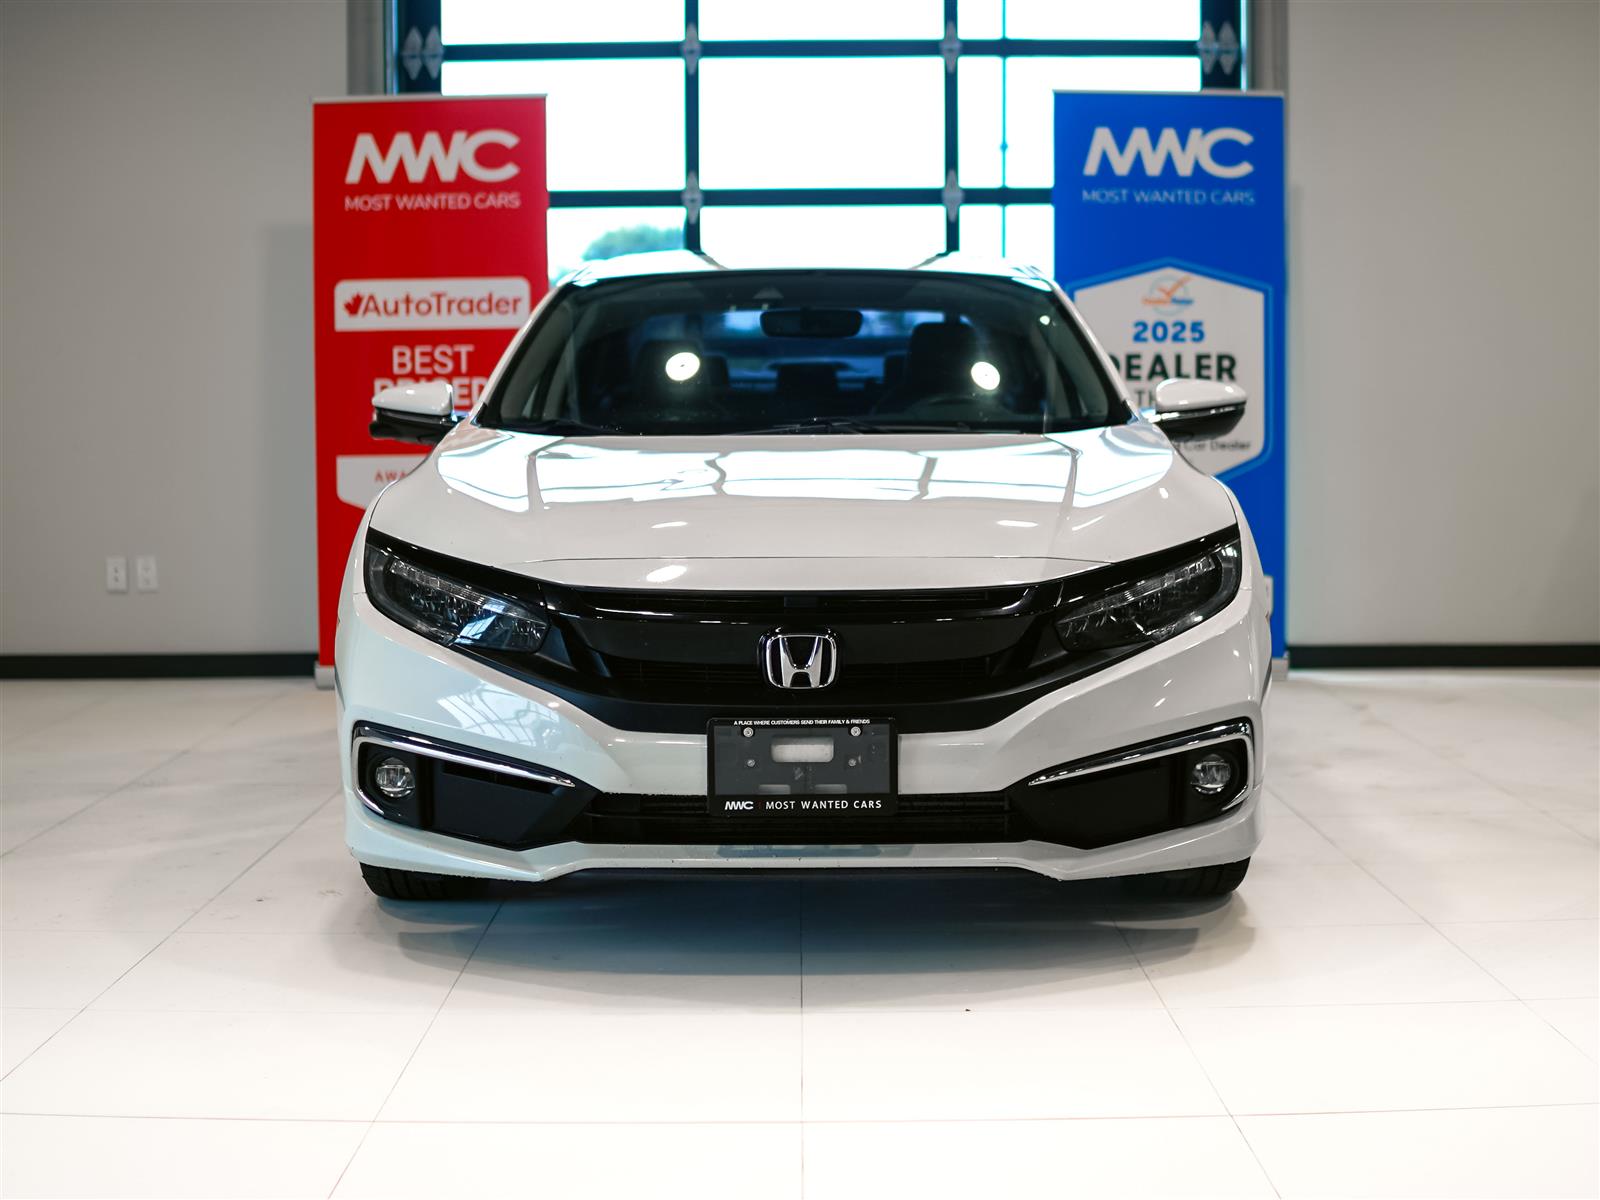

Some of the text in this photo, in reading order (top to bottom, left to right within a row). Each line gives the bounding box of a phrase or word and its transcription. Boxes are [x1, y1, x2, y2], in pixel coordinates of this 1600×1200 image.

[344, 128, 520, 184] MWC
[1083, 127, 1254, 179] MWC
[344, 192, 522, 211] MOST WANTED CARS
[1082, 188, 1256, 206] MOST WANTED CARS
[362, 291, 522, 317] AutoTrader
[1132, 321, 1205, 343] 2025
[392, 344, 475, 375] BEST
[724, 800, 882, 810] MWC MOST WANTED CARS
